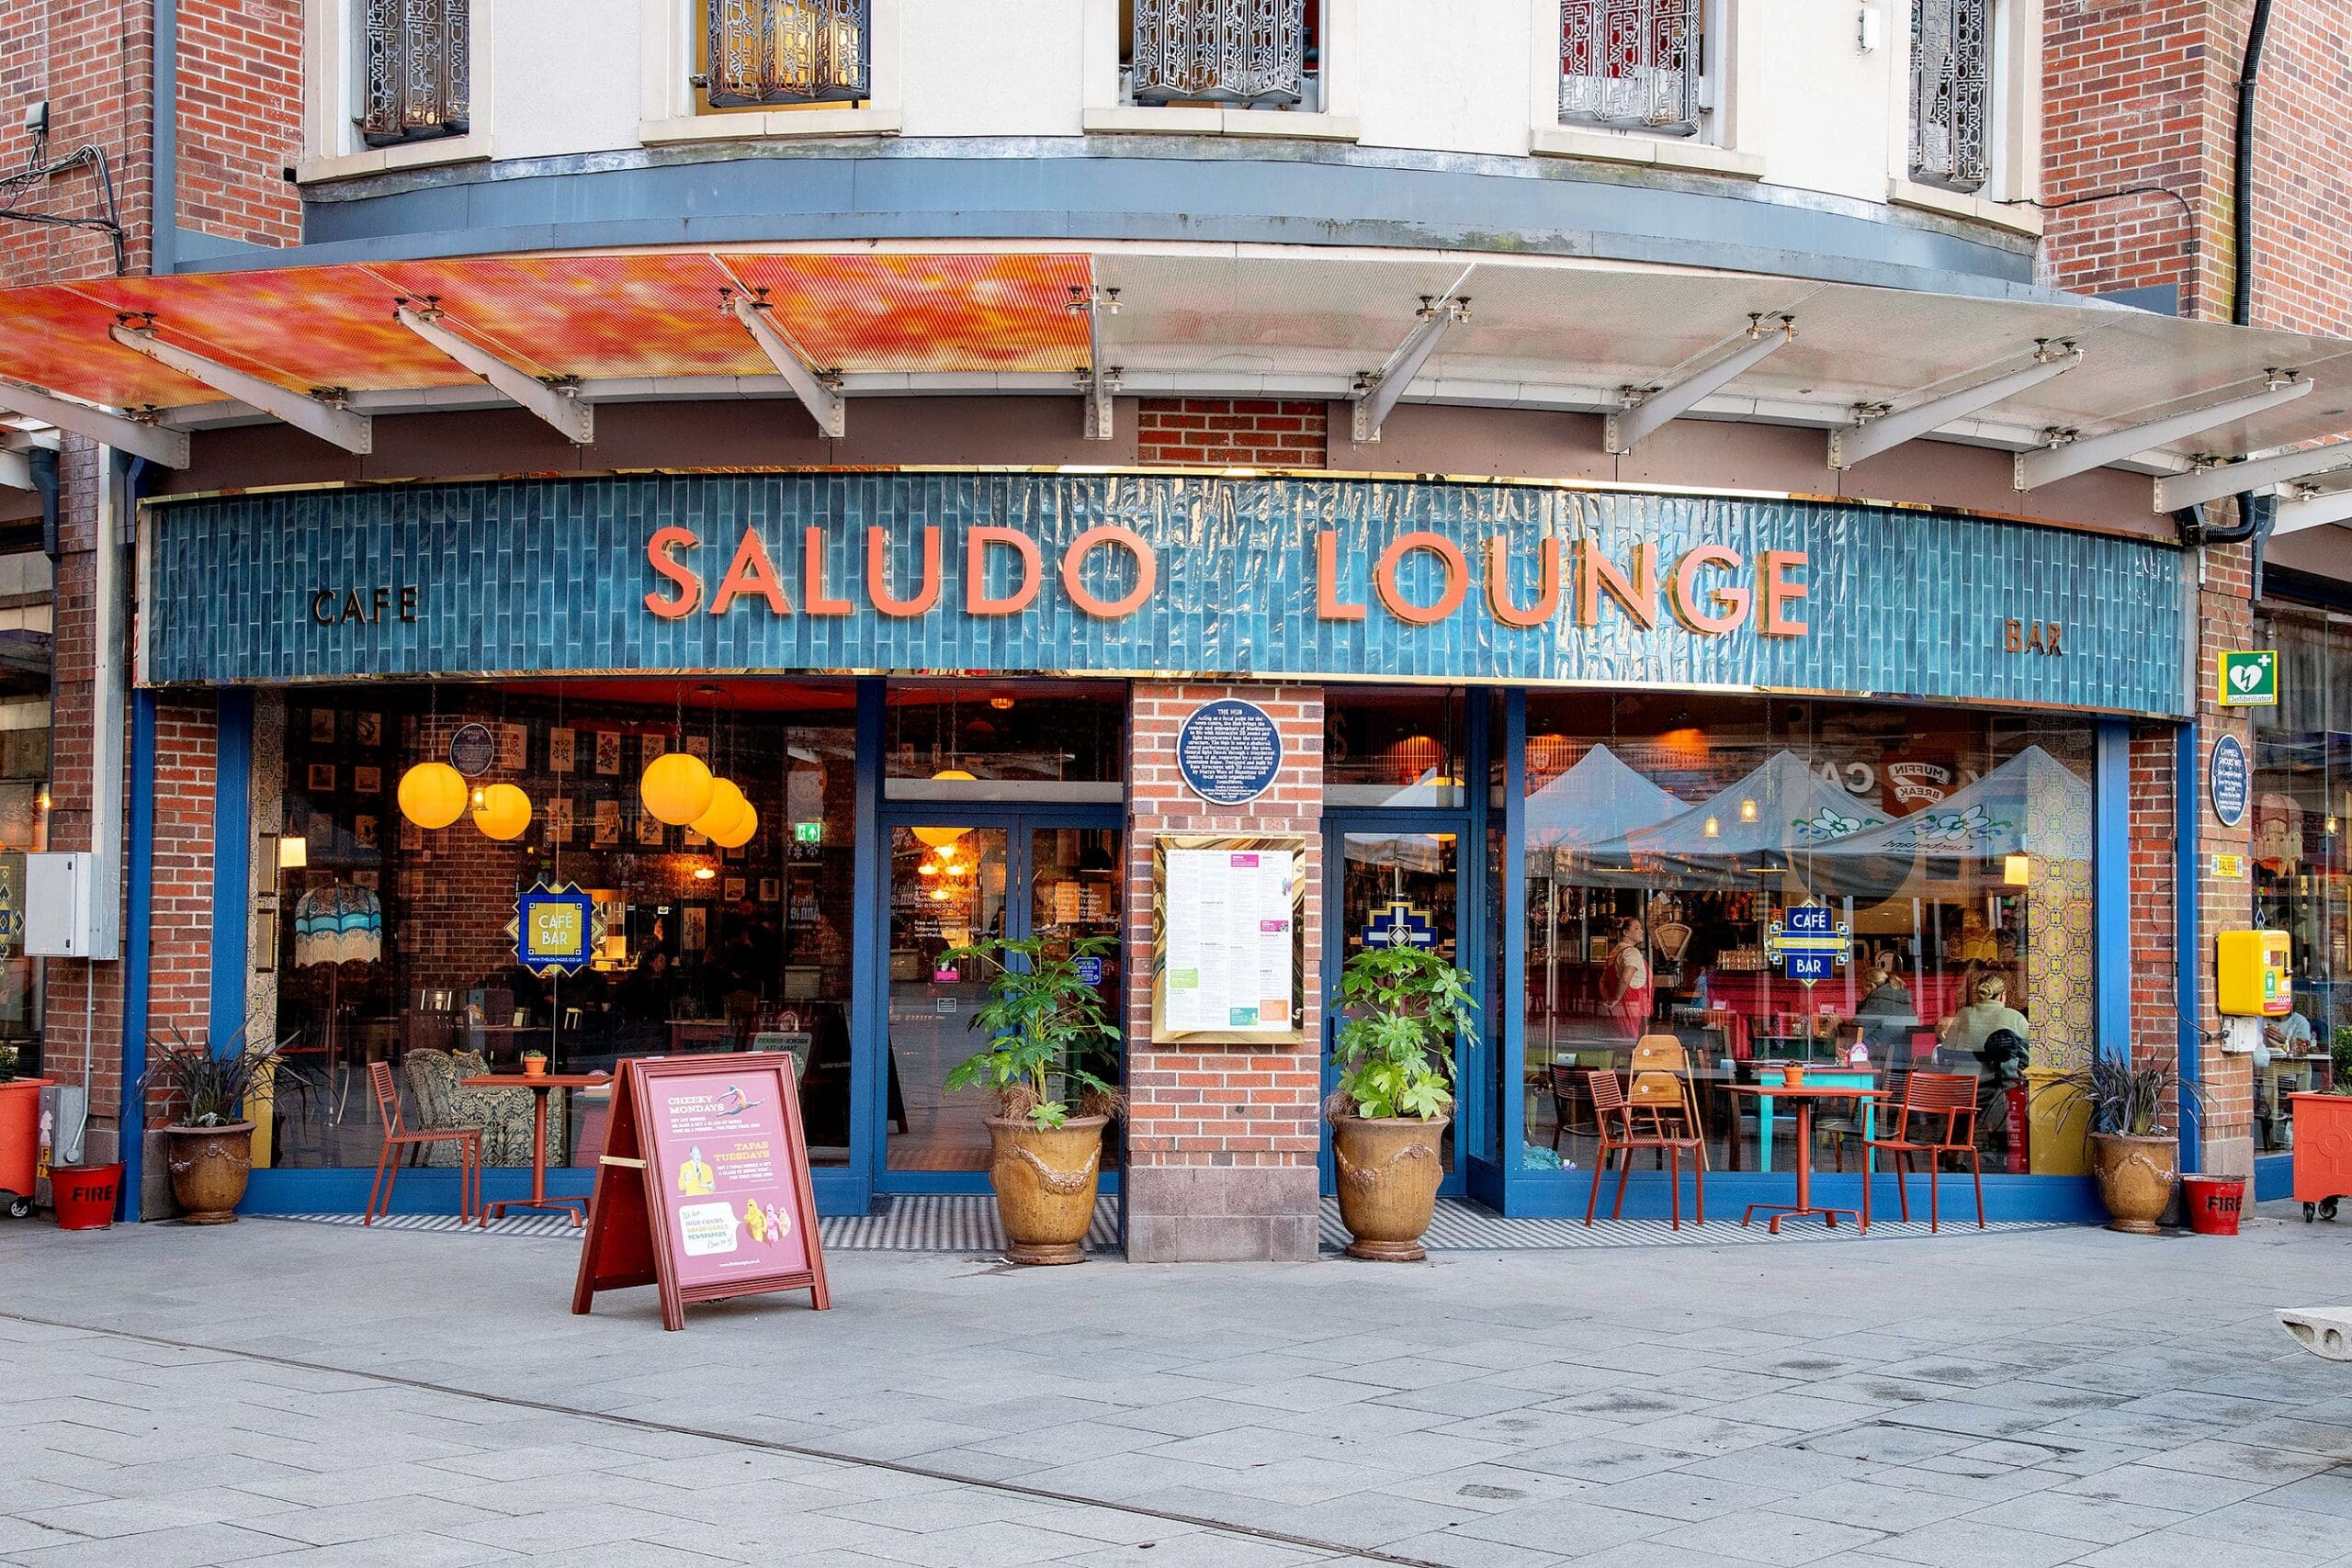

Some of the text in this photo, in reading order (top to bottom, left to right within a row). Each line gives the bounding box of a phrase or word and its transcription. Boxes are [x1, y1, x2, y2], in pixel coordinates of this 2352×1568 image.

[644, 525, 1809, 637] SALUDO LOUNGE
[312, 587, 418, 626] CAFE
[2005, 617, 2063, 657] BAR
[537, 912, 573, 929] CAFÉ
[1792, 911, 1826, 928] CAFÉ
[542, 931, 568, 945] BAR
[1796, 959, 1821, 973] BAR
[668, 1096, 713, 1105] CHEEKY
[669, 1104, 724, 1114] MONDAYS
[734, 1141, 768, 1151] TAPAS
[713, 1150, 770, 1161] TUESDAYS
[73, 1185, 114, 1202] FIRE
[2207, 1196, 2242, 1212] FIRE
[687, 1231, 727, 1240] NEWSPAPERS
